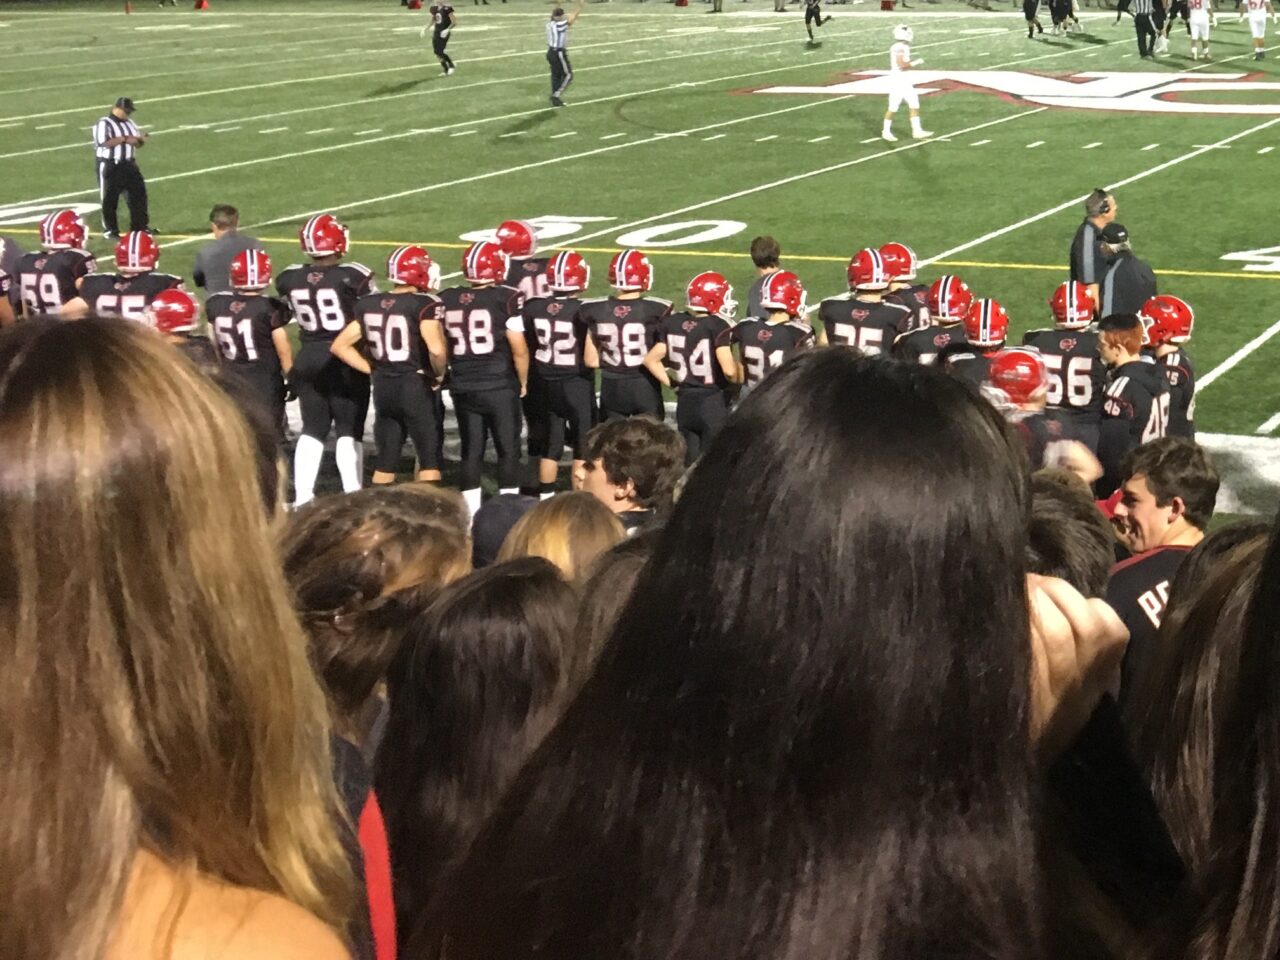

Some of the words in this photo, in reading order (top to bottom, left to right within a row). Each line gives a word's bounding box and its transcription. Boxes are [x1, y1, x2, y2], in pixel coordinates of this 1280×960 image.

[290, 288, 346, 331] 68
[445, 309, 494, 355] 58
[363, 313, 410, 361] 50
[597, 323, 648, 367] 38
[667, 334, 714, 384] 54
